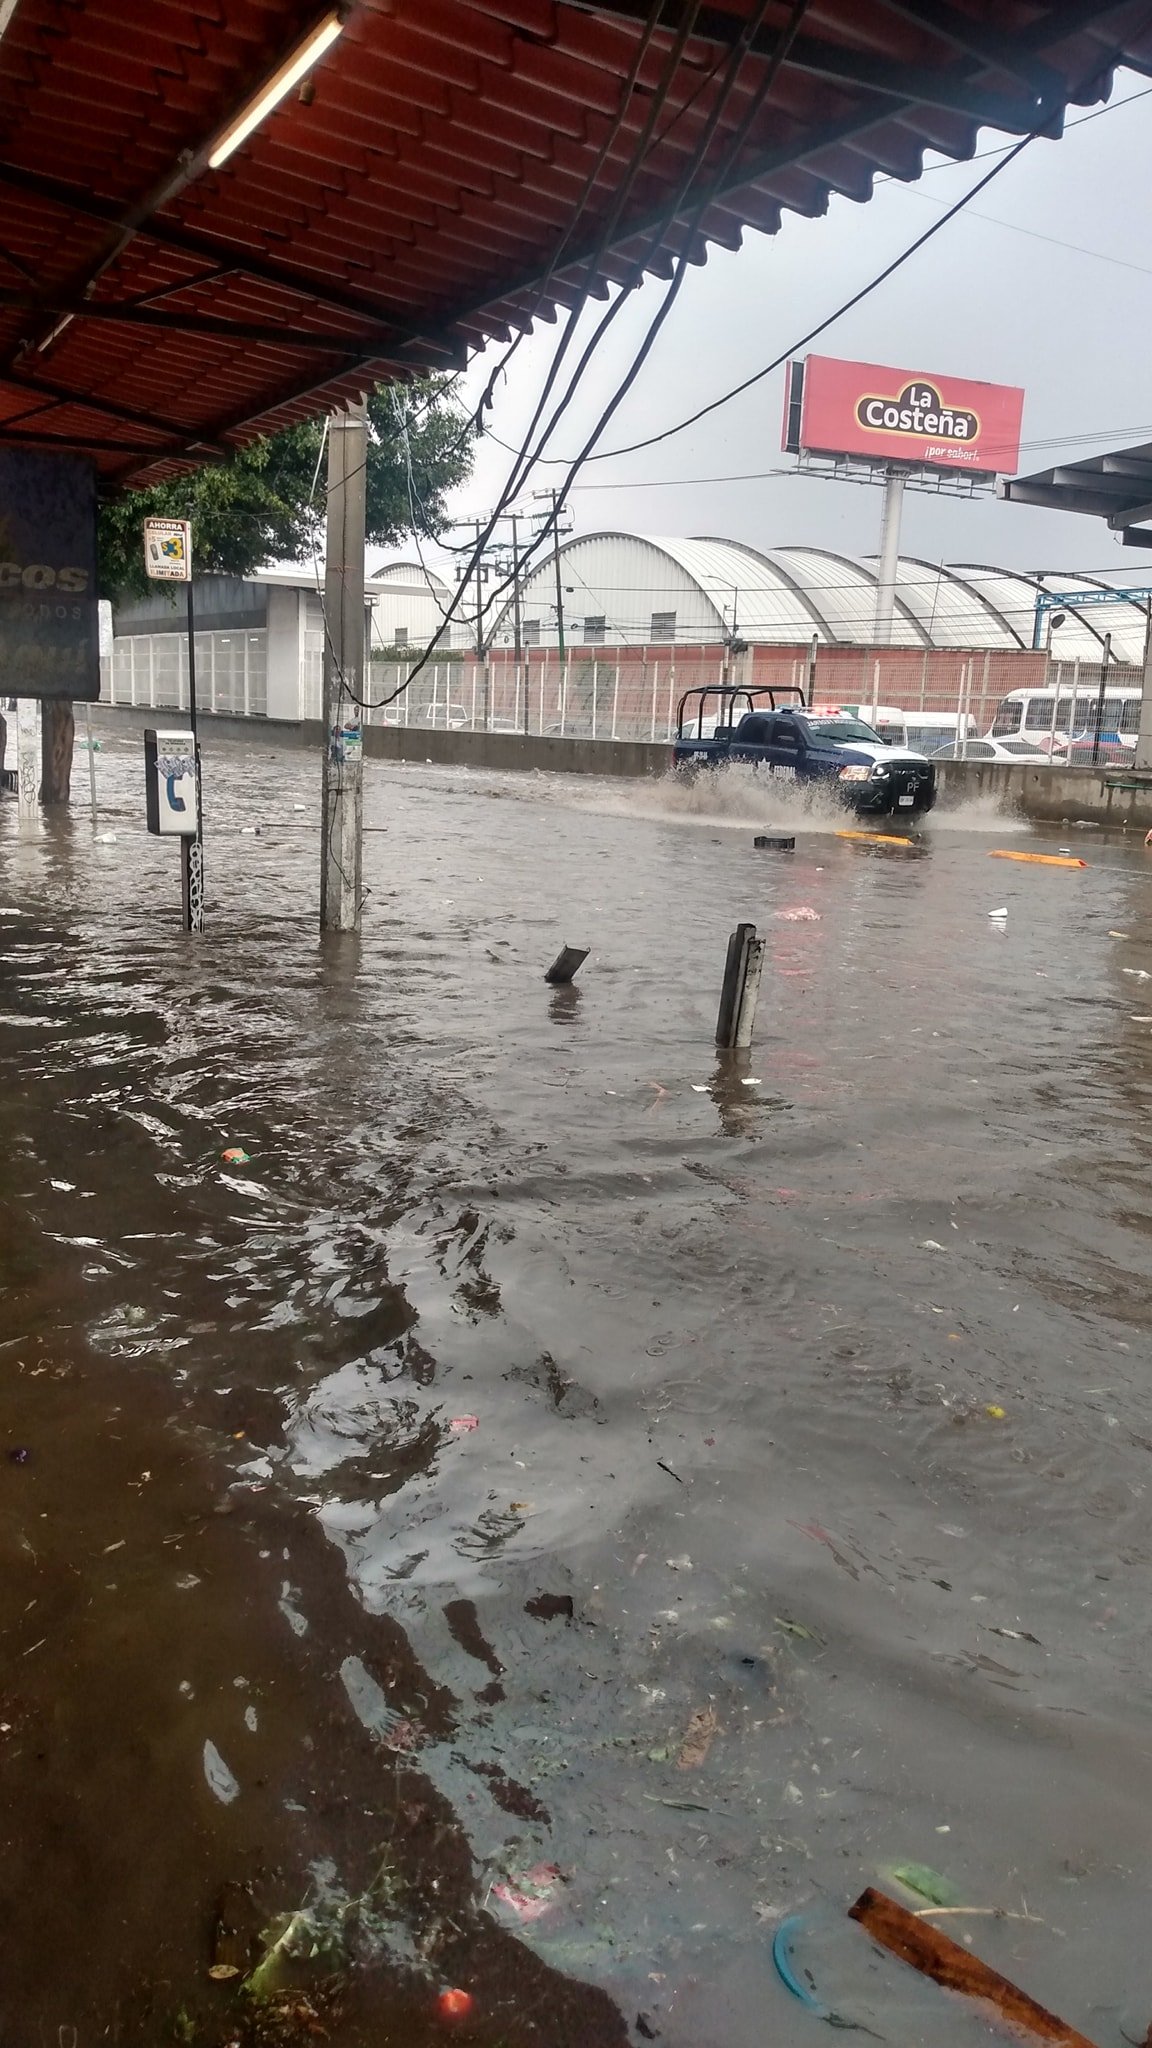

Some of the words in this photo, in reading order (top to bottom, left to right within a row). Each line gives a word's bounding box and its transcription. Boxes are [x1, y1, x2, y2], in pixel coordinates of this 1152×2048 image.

[910, 386, 932, 408] La
[866, 400, 969, 438] Costeña
[924, 446, 946, 459] ¡por
[149, 521, 183, 531] AHORRA
[906, 782, 920, 792] PF
